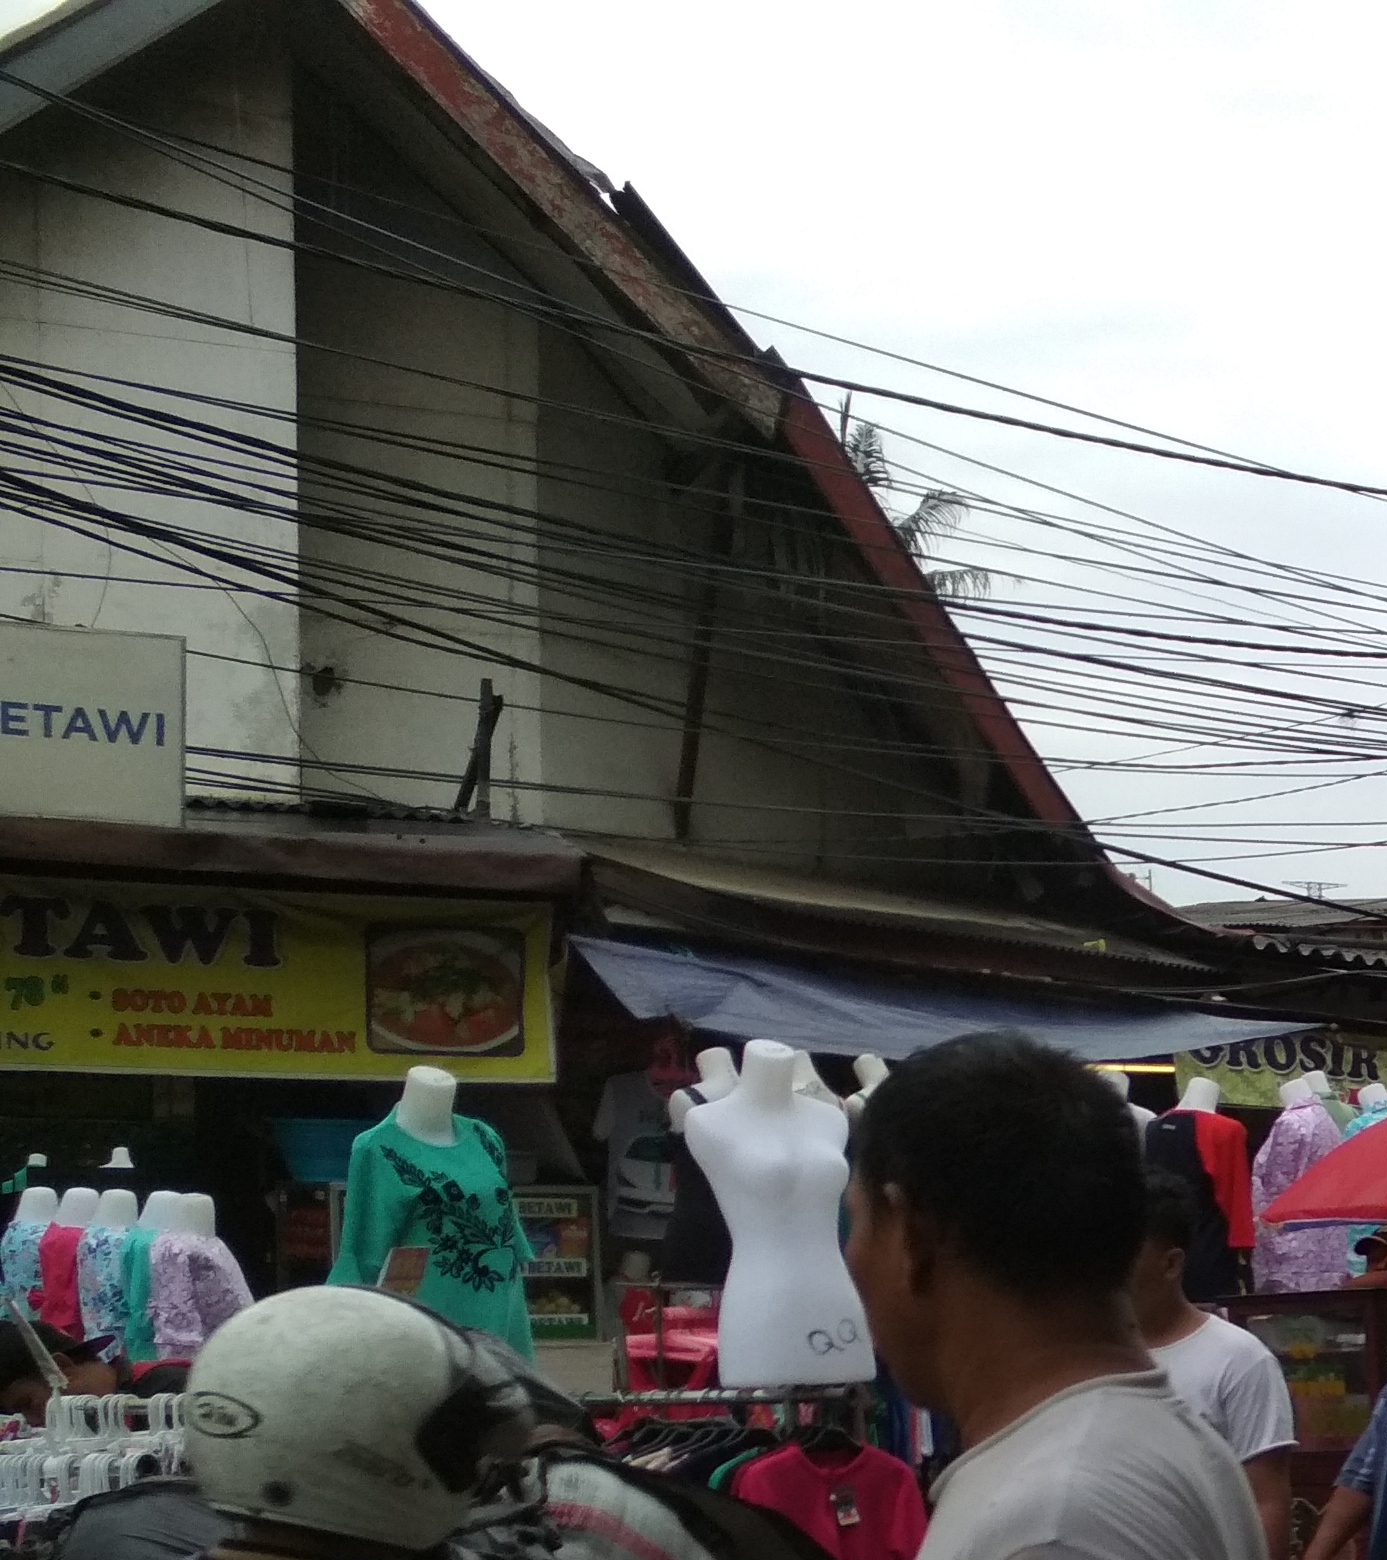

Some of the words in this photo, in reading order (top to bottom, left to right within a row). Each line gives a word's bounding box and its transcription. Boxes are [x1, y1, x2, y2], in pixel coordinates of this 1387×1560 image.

[0, 700, 166, 748] ETAWI
[0, 897, 282, 967] TAWI
[111, 988, 187, 1014] SOTO
[192, 992, 273, 1017] AYAM
[112, 1022, 216, 1049] ANEKA
[220, 1026, 356, 1053] MINUMAN
